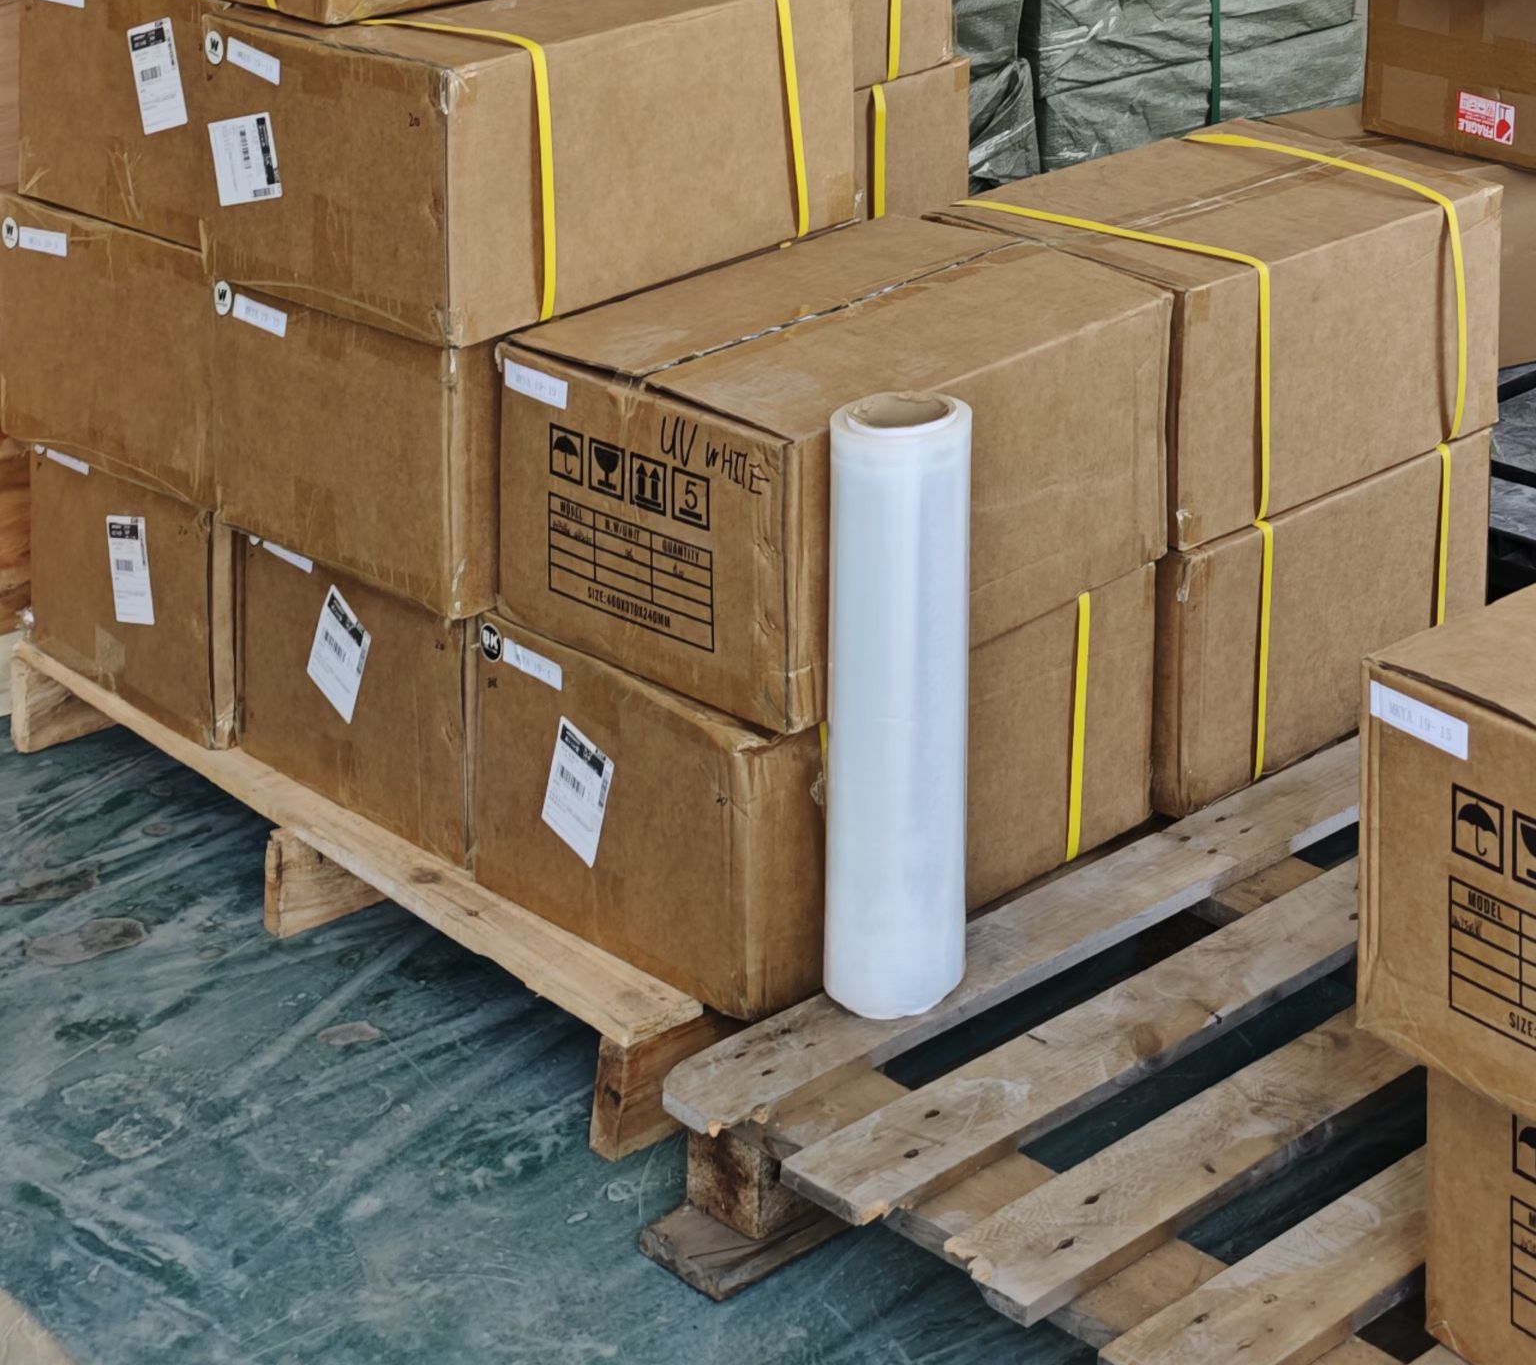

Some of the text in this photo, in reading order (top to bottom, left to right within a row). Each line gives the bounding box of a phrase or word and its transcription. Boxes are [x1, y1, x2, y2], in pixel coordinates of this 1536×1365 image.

[1457, 118, 1494, 139] FRAGILE
[661, 416, 698, 467] UV
[685, 480, 698, 510] 5
[559, 501, 583, 521] MODEL
[661, 539, 700, 563] QUANTITY
[1468, 890, 1503, 922] MODEL
